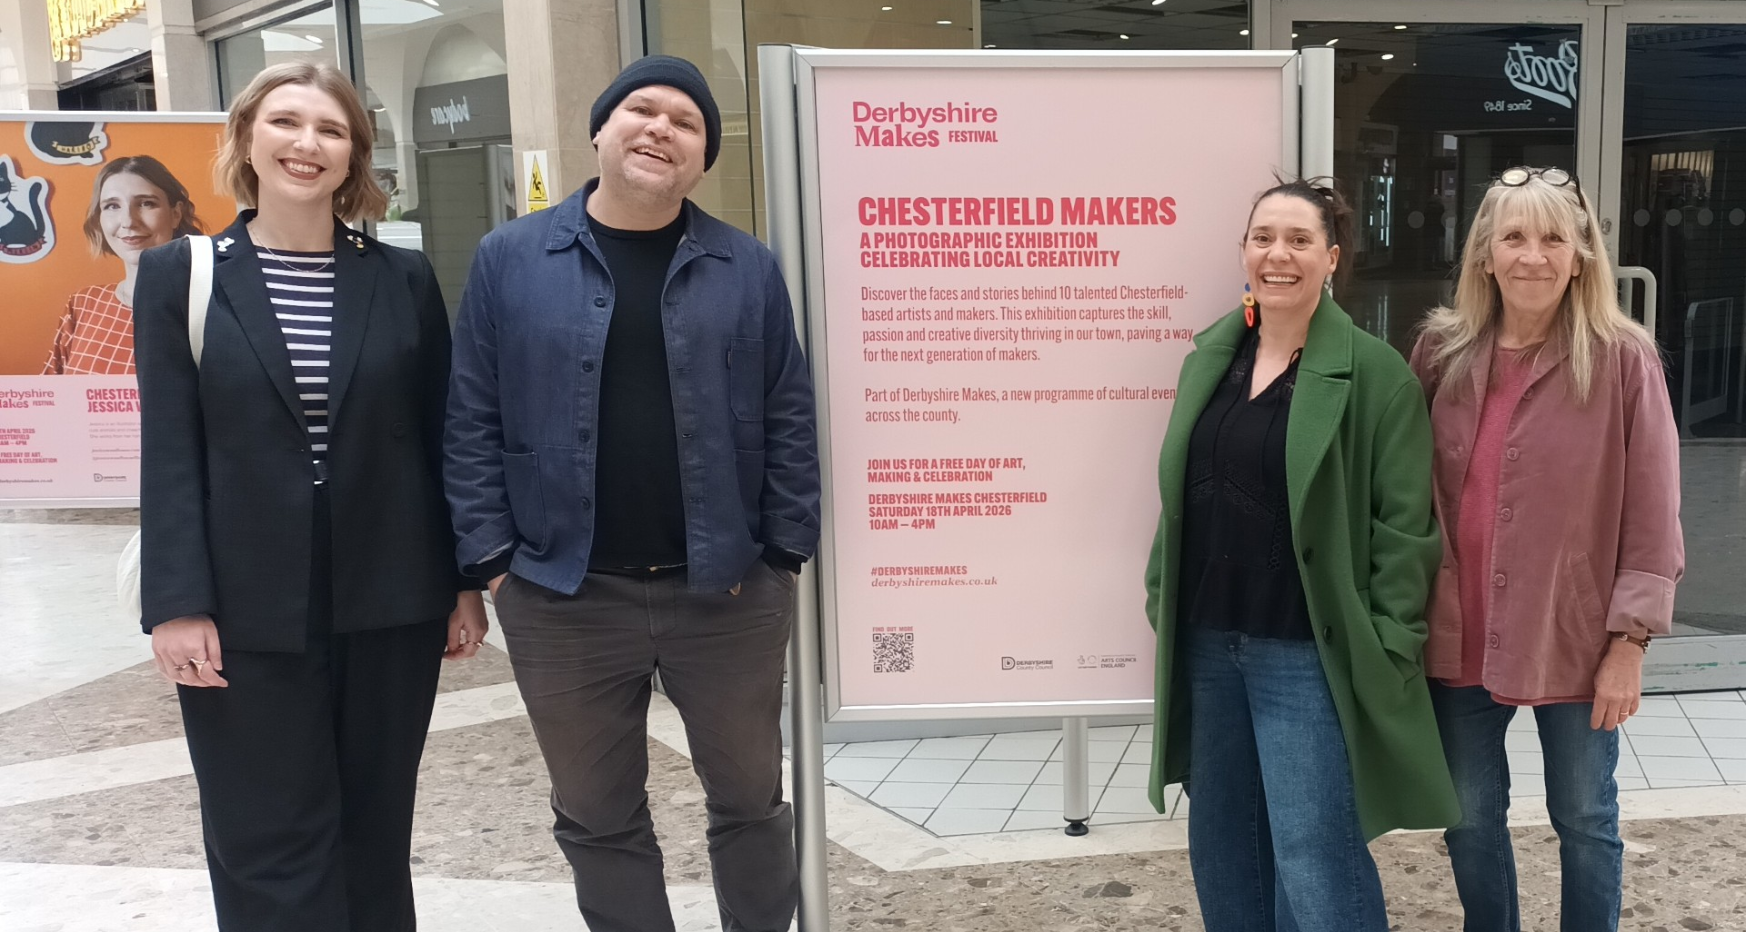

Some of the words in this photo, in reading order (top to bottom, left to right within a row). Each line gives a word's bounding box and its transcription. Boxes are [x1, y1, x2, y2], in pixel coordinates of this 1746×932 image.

[853, 102, 997, 129] Derbyshire
[855, 124, 939, 147] Makes
[949, 131, 998, 142] FESTIVAL
[859, 197, 1053, 226] CHESTERFIELD
[1061, 197, 1176, 225] MAKERS
[860, 232, 871, 249] A
[874, 232, 1002, 249] PHOTOGRAPHIC
[1006, 232, 1097, 248] EXHIBITION
[861, 251, 970, 268] CELEBRATING
[974, 251, 1023, 267] LOCAL
[1027, 251, 1120, 267] CREATIVITY
[861, 287, 907, 300] Discover
[910, 287, 926, 300] the
[929, 287, 958, 300] faces
[961, 287, 980, 300] and
[983, 287, 1019, 300] stories
[1022, 286, 1056, 300] behind
[1060, 286, 1071, 300] 10
[1074, 286, 1117, 299] talented
[1121, 285, 1188, 299] Chesterfield-
[862, 307, 893, 321] based
[896, 307, 931, 321] artists
[934, 307, 953, 320] and
[957, 307, 998, 320] makers.
[1000, 307, 1022, 320] This
[1025, 306, 1076, 320] exhibition
[1079, 307, 1125, 322] captures
[1127, 306, 1144, 319] the
[1147, 305, 1171, 321] skill,
[863, 328, 903, 344] passion
[906, 328, 925, 341] and
[928, 327, 970, 341] creative
[974, 327, 1019, 343] diversity
[1021, 327, 1062, 343] thriving
[1065, 327, 1073, 340] in
[1077, 330, 1093, 340] our
[1096, 327, 1124, 342] town,
[1127, 326, 1162, 342] paving
[1164, 329, 1170, 339] a
[1173, 329, 1194, 342] way
[864, 348, 878, 362] for
[881, 348, 898, 361] the
[901, 349, 924, 361] next
[927, 348, 983, 364] generation
[986, 347, 996, 361] of
[999, 347, 1040, 360] makers.
[0, 389, 54, 400] erbyshire
[865, 388, 887, 402] Part
[890, 388, 900, 402] of
[903, 388, 959, 404] Derbyshire
[962, 388, 999, 402] Makes,
[1002, 391, 1008, 401] a
[1011, 390, 1031, 401] new
[1034, 390, 1093, 403] programme
[1097, 386, 1107, 400] of
[1109, 386, 1149, 400] cultural
[1151, 388, 1176, 400] even
[0, 398, 29, 408] akes
[88, 401, 133, 412] JESSICA
[866, 411, 900, 422] across
[903, 408, 920, 421] the
[923, 409, 960, 424] county.
[867, 459, 890, 470] JOIN
[893, 459, 907, 470] US
[909, 459, 929, 469] FOR
[931, 459, 938, 469] A
[940, 459, 964, 469] FREE
[966, 458, 986, 469] DAY
[989, 458, 1001, 469] OF
[1003, 458, 1026, 471] ART,
[868, 472, 911, 482] MAKING
[913, 472, 921, 482] &
[923, 471, 992, 482] CELEBRATION
[869, 494, 933, 504] DERBYSHIRE
[935, 493, 972, 504] MAKES
[974, 492, 1047, 503] CHESTERFIELD
[869, 506, 923, 517] SATURDAY
[926, 506, 951, 516] 18TH
[953, 506, 983, 516] APRIL
[985, 505, 1011, 516] 2026
[869, 519, 898, 530] 10AM
[911, 519, 935, 529] 4PM
[871, 566, 967, 576] #DERBYSHIREMAKES
[872, 576, 998, 589] derbyshiremakes.co.uk
